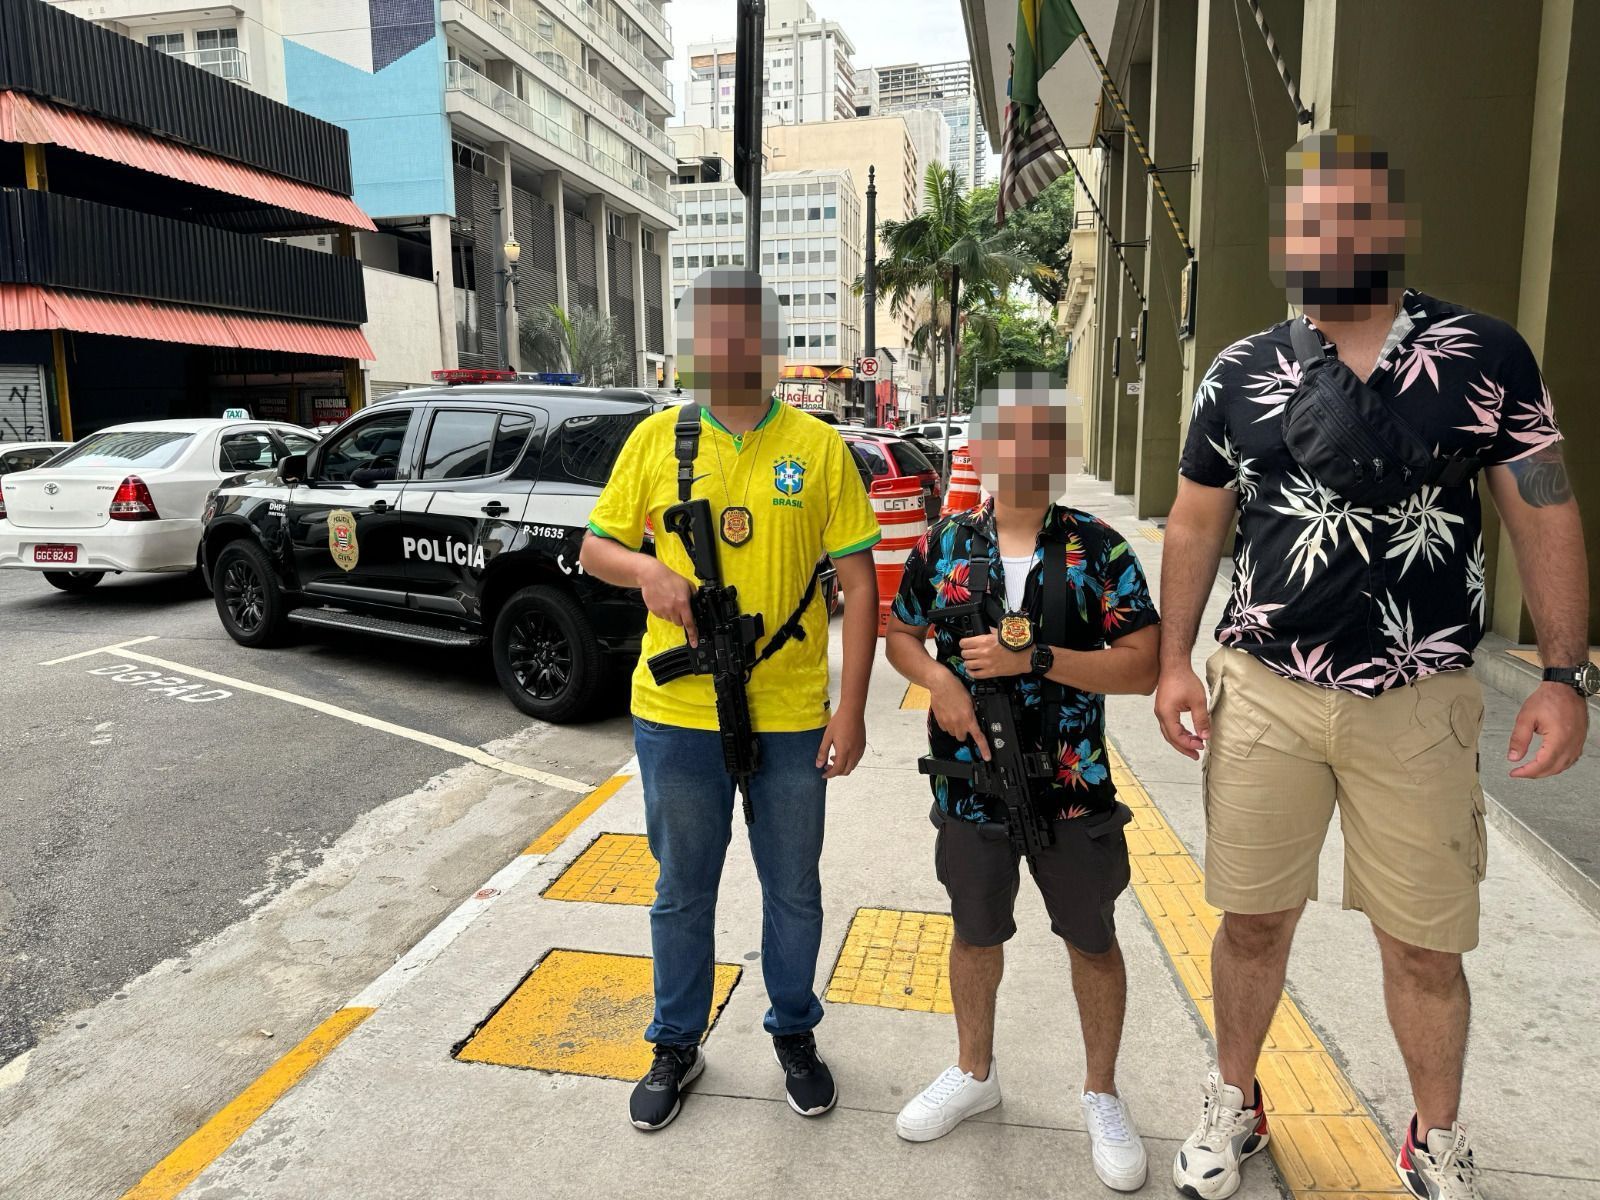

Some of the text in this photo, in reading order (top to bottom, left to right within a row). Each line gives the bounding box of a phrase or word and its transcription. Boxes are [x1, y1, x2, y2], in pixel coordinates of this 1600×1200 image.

[226, 410, 243, 419] TAXI
[772, 497, 804, 509] BRASIL
[883, 498, 909, 511] CET
[522, 524, 565, 540] P-31635
[402, 536, 486, 570] POLÍCIA
